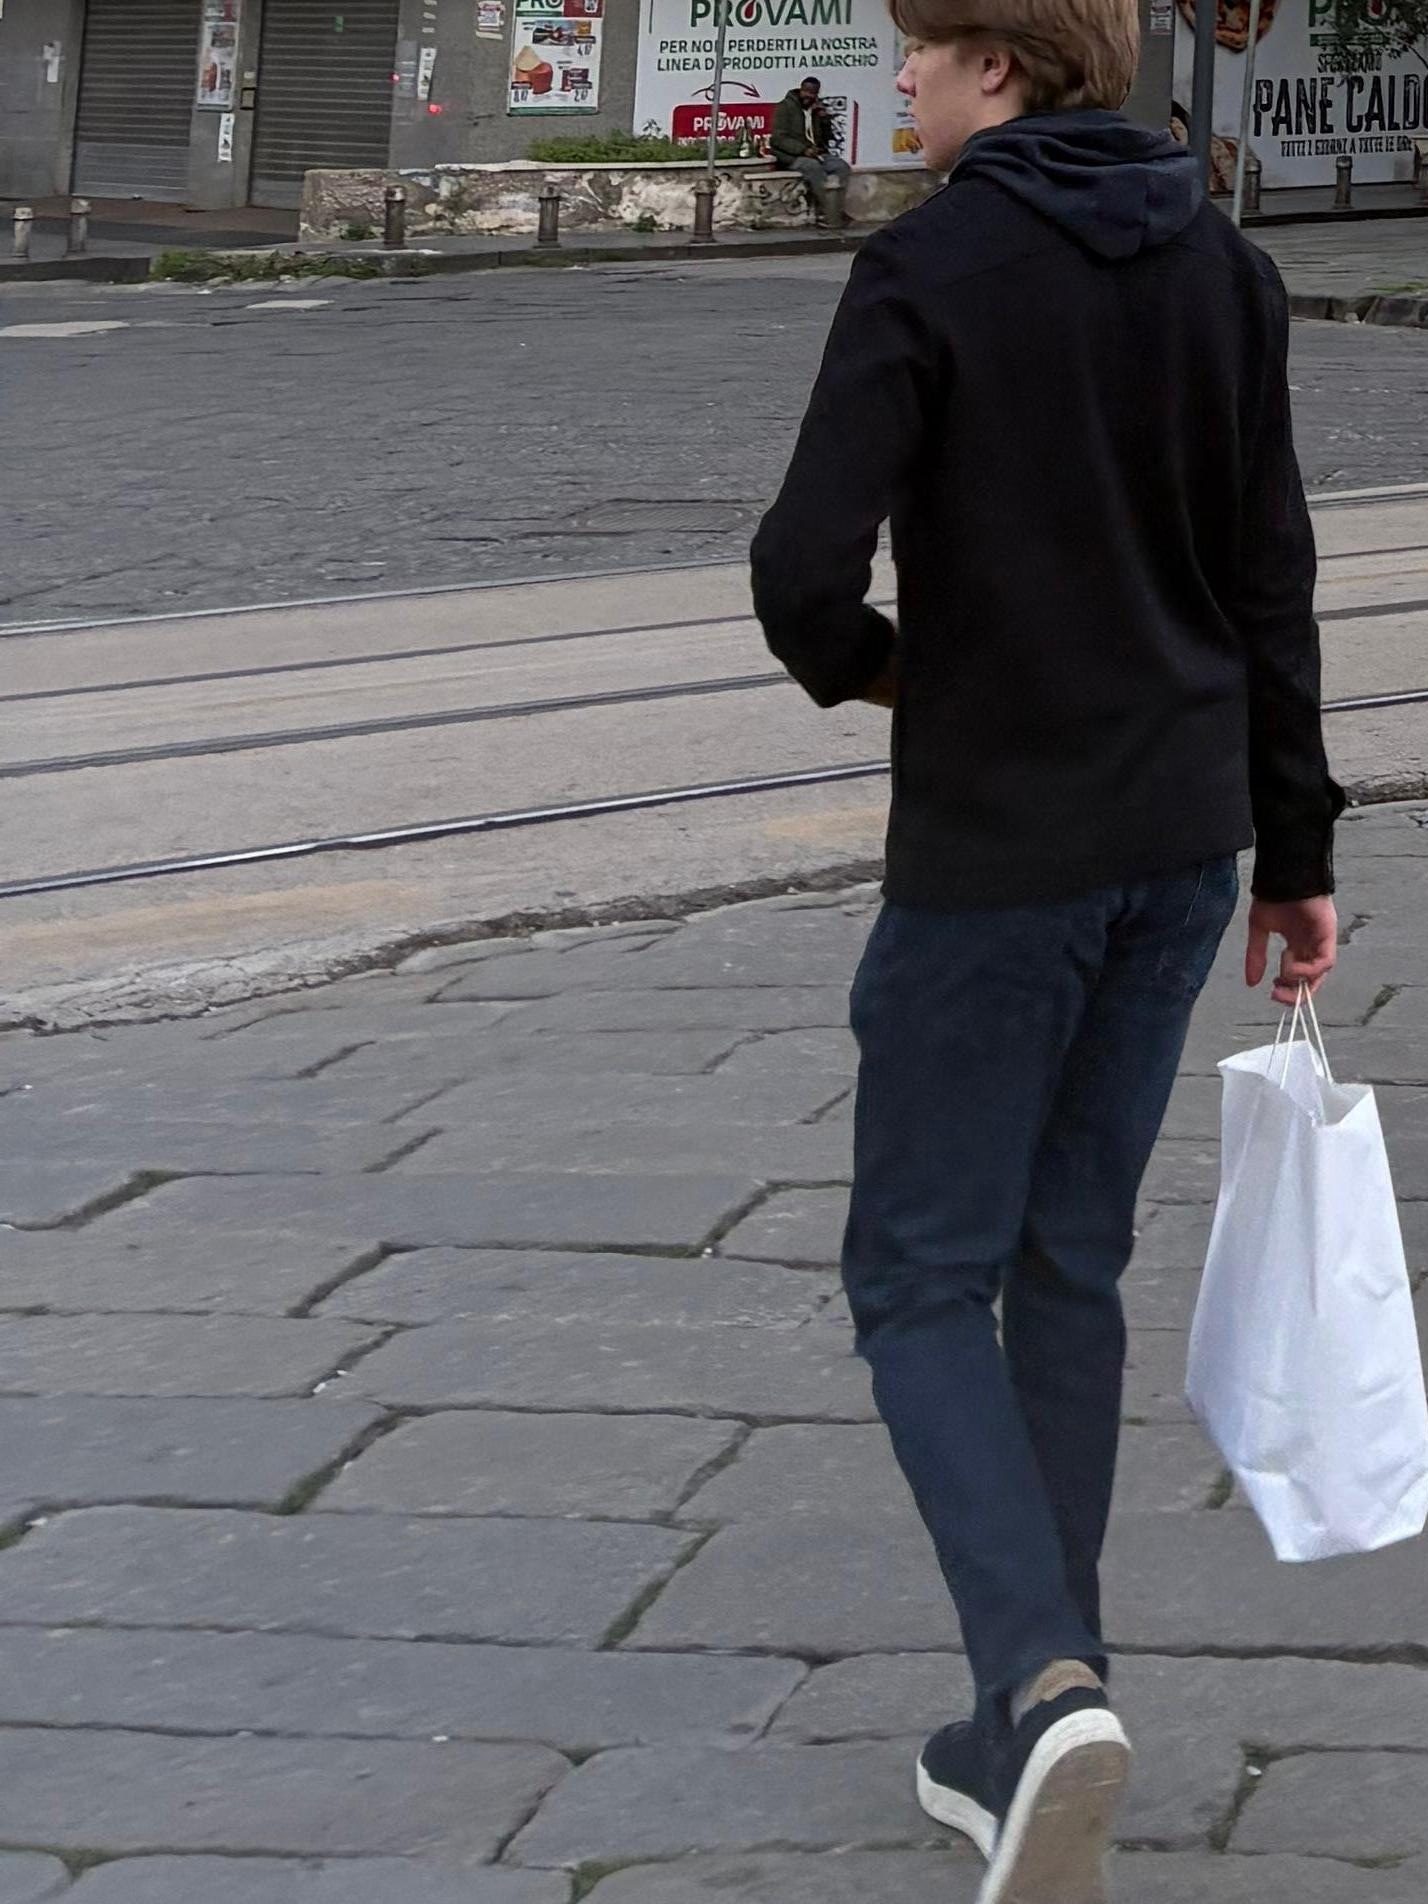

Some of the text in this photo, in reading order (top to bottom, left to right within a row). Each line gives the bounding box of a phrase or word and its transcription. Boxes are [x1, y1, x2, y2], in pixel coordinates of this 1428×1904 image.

[660, 40, 688, 53] PER
[728, 38, 798, 52] PERDERTI
[801, 38, 818, 50] LA
[821, 37, 877, 50] NOSTRA
[657, 58, 701, 71] LINEA
[723, 56, 795, 70] PRODOTTI
[799, 56, 808, 68] A
[811, 54, 878, 68] MARCHIO
[1253, 77, 1334, 136] PANE
